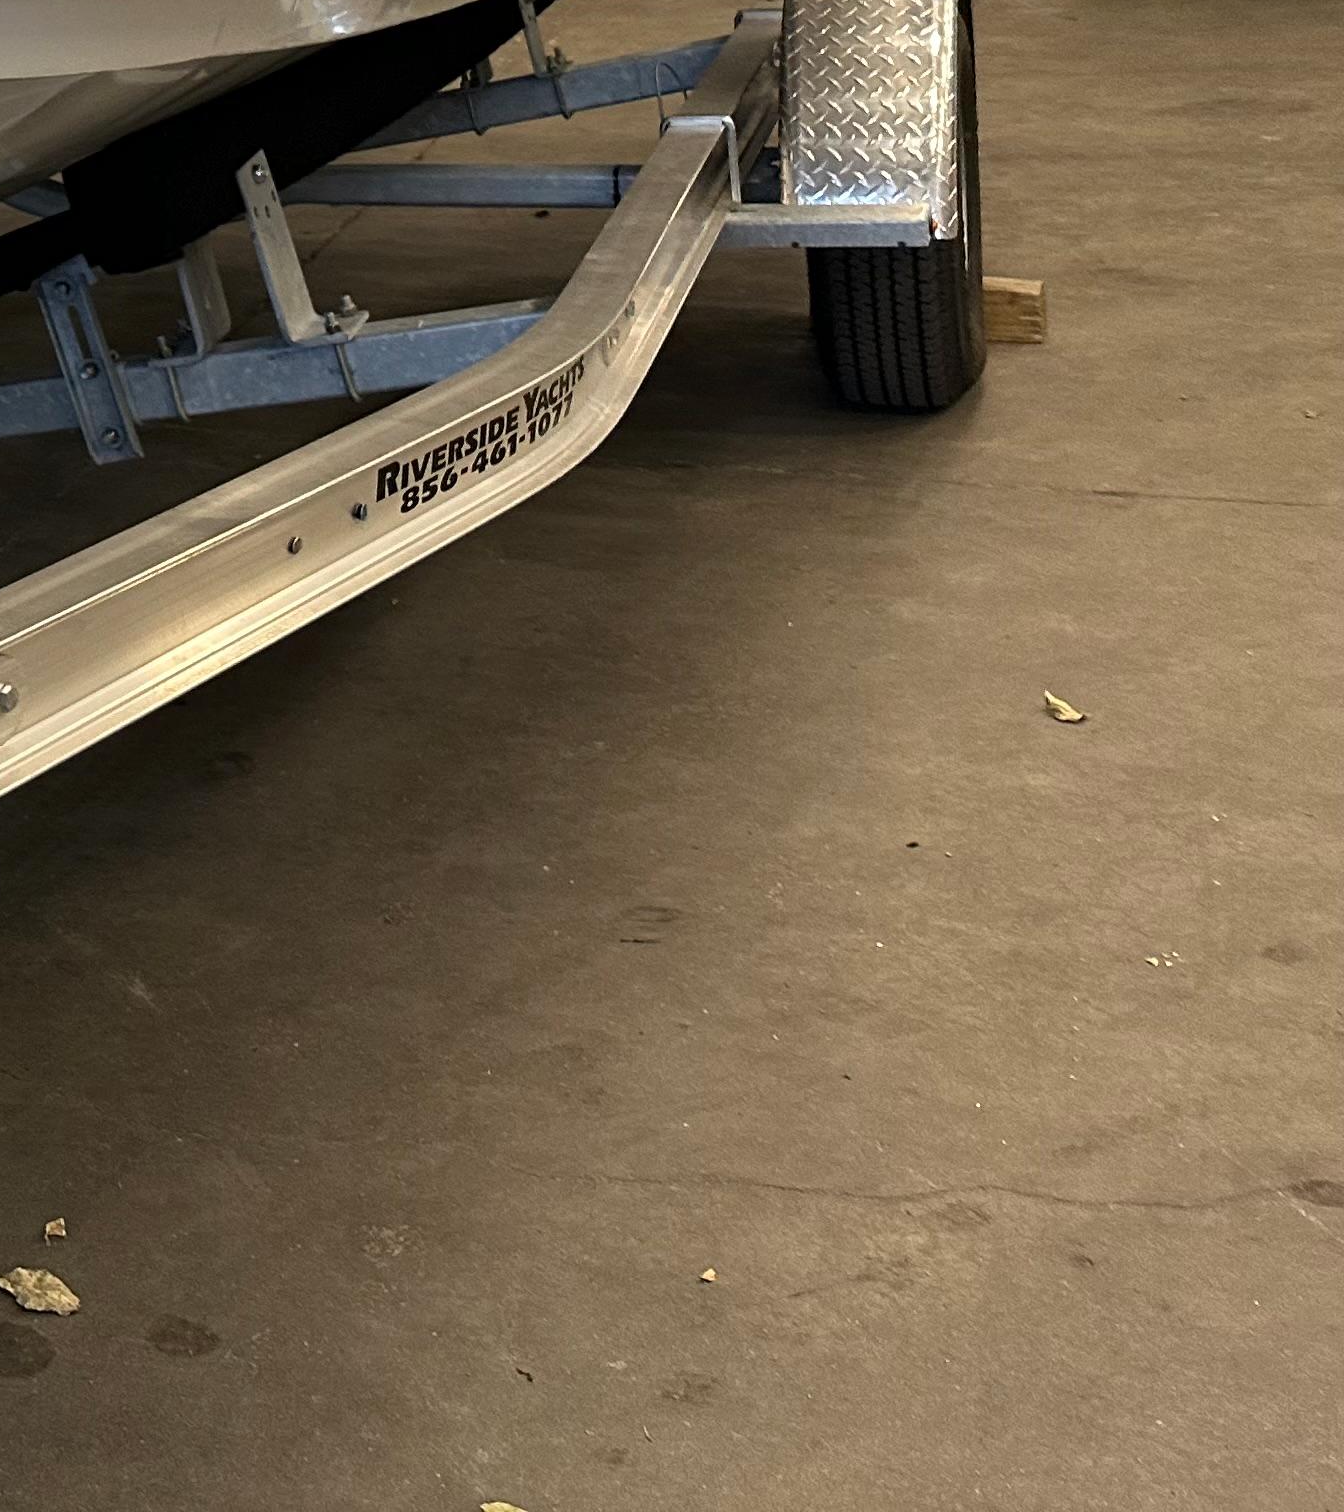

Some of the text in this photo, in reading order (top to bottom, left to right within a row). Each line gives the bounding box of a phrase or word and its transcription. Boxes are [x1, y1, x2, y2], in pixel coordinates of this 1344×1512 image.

[376, 354, 585, 503] RIVERSIDE YACHTS
[400, 391, 574, 514] 856-461-1077
